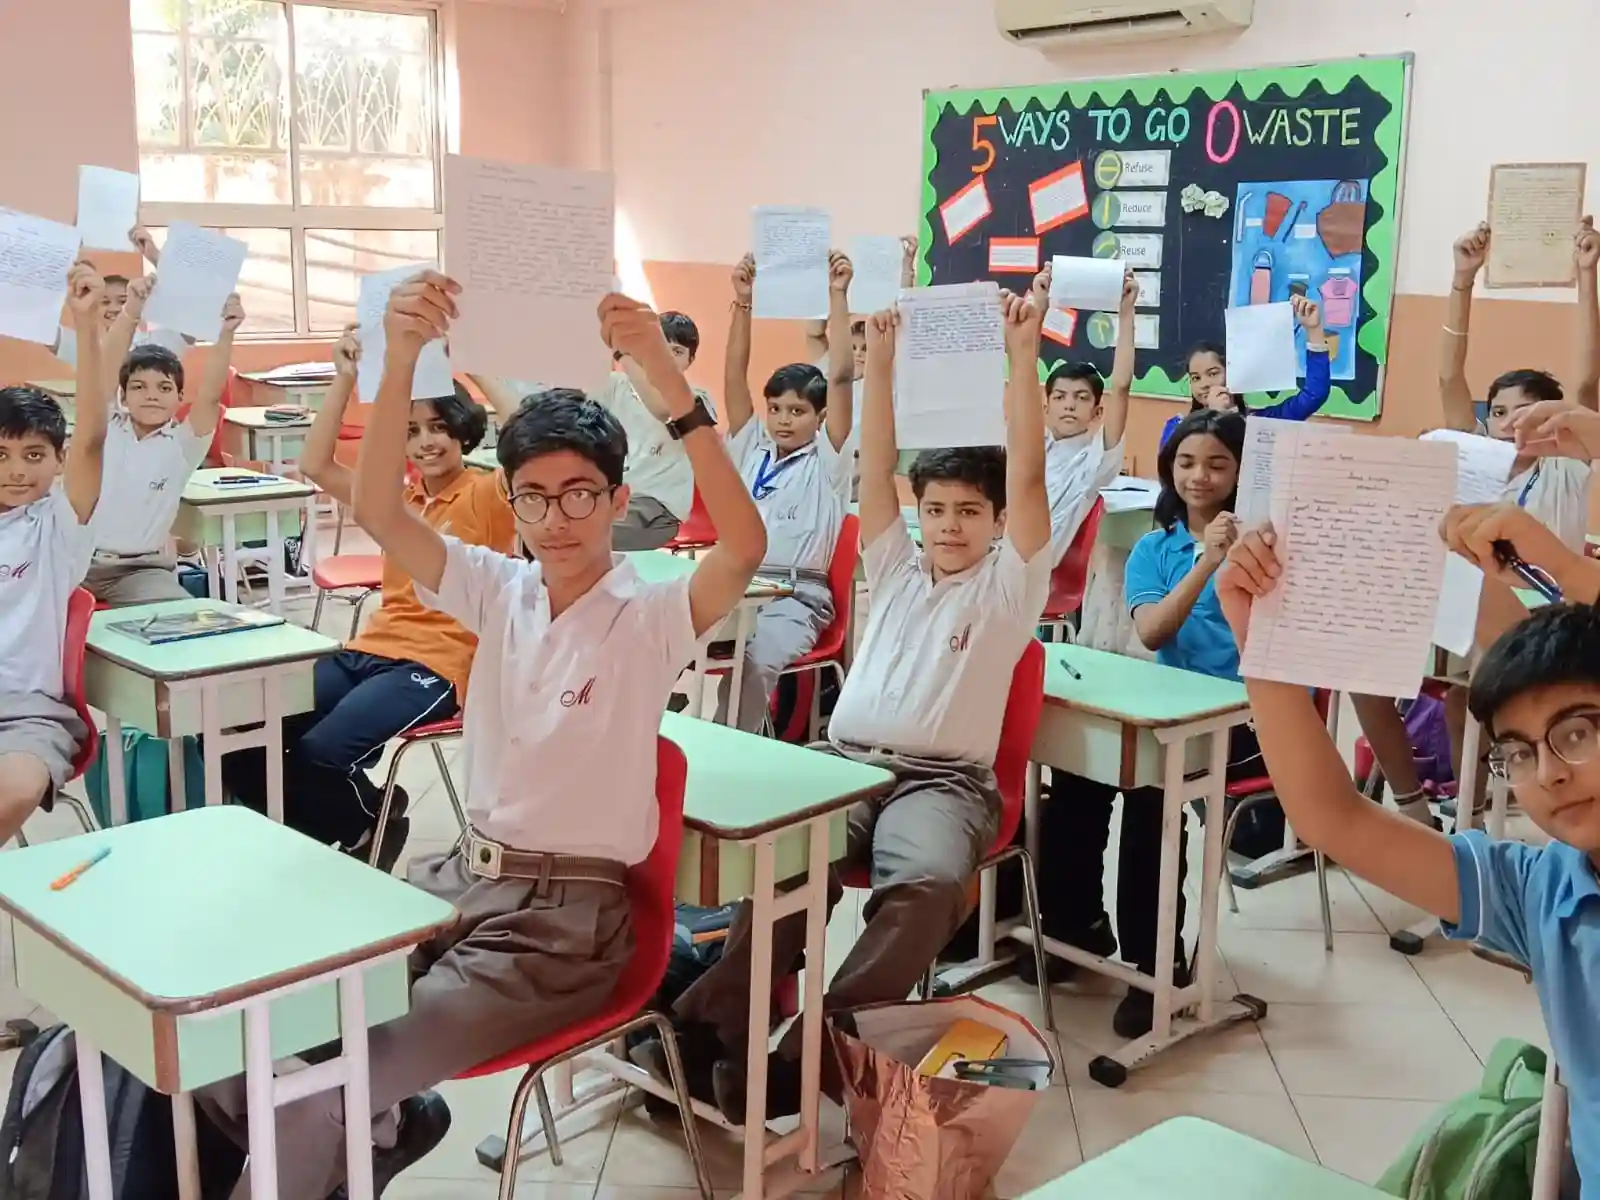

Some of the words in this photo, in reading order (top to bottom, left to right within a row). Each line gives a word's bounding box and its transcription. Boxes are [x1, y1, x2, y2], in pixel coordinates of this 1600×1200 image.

[971, 115, 997, 173] 5
[998, 110, 1070, 151] WAYS
[1088, 107, 1132, 144] TO
[1145, 106, 1190, 143] GO
[1242, 107, 1361, 146] WASTE
[1125, 162, 1154, 173] Refuse
[1121, 244, 1146, 256] Reuse
